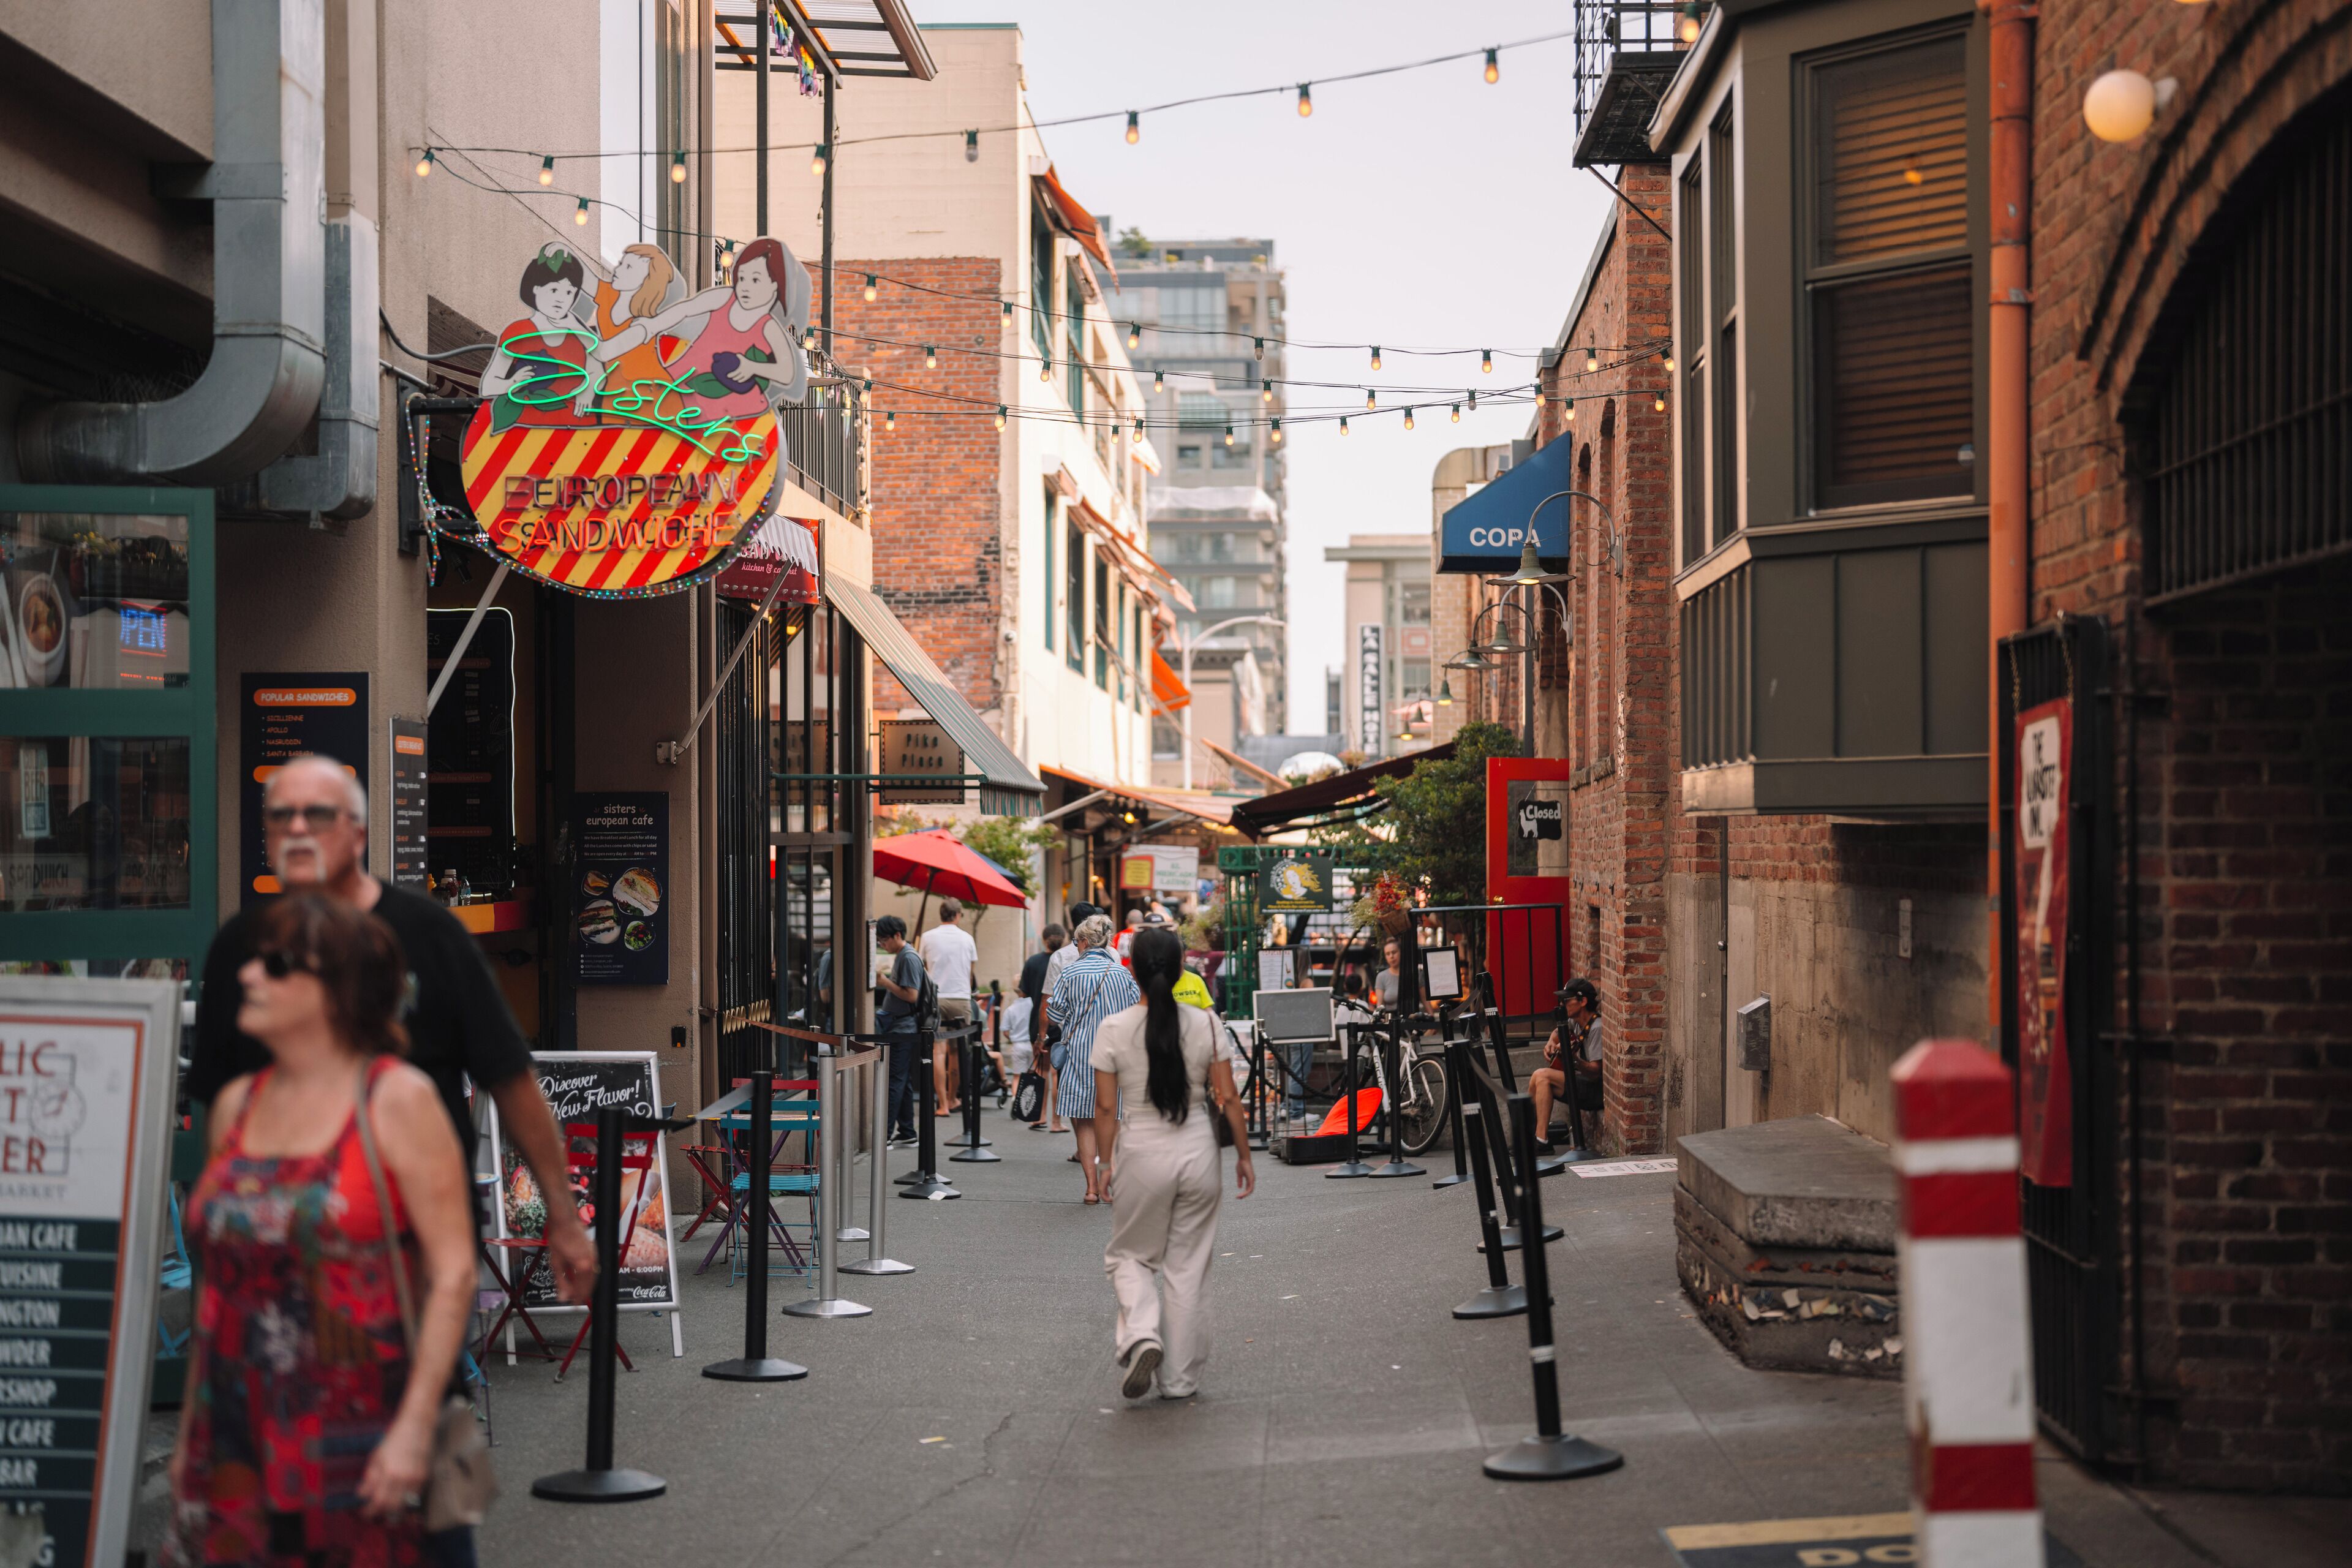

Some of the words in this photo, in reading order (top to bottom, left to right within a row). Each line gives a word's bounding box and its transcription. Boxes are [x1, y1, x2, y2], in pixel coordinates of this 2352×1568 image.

[502, 330, 764, 462] Sisters
[504, 469, 737, 511] EUROPEAN
[1469, 527, 1541, 548] COPA
[742, 562, 764, 572] kitchen
[766, 564, 773, 574] &
[120, 608, 165, 650] PEN
[1363, 625, 1379, 649] LA
[1362, 652, 1379, 708] SALLE
[260, 693, 295, 702] POPULAR
[296, 692, 349, 701] SANDWICHES
[1362, 710, 1380, 756] HOTE
[586, 816, 628, 828] european
[632, 814, 654, 826] cafe
[603, 804, 636, 814] sisters
[1526, 802, 1561, 820] Closed
[536, 1074, 598, 1098] Discover
[545, 1090, 581, 1120] New
[582, 1079, 641, 1112] Flavor!
[0, 1183, 67, 1199] ARKET
[31, 1222, 77, 1251] CAFE
[633, 1285, 668, 1299] Coca-Cola
